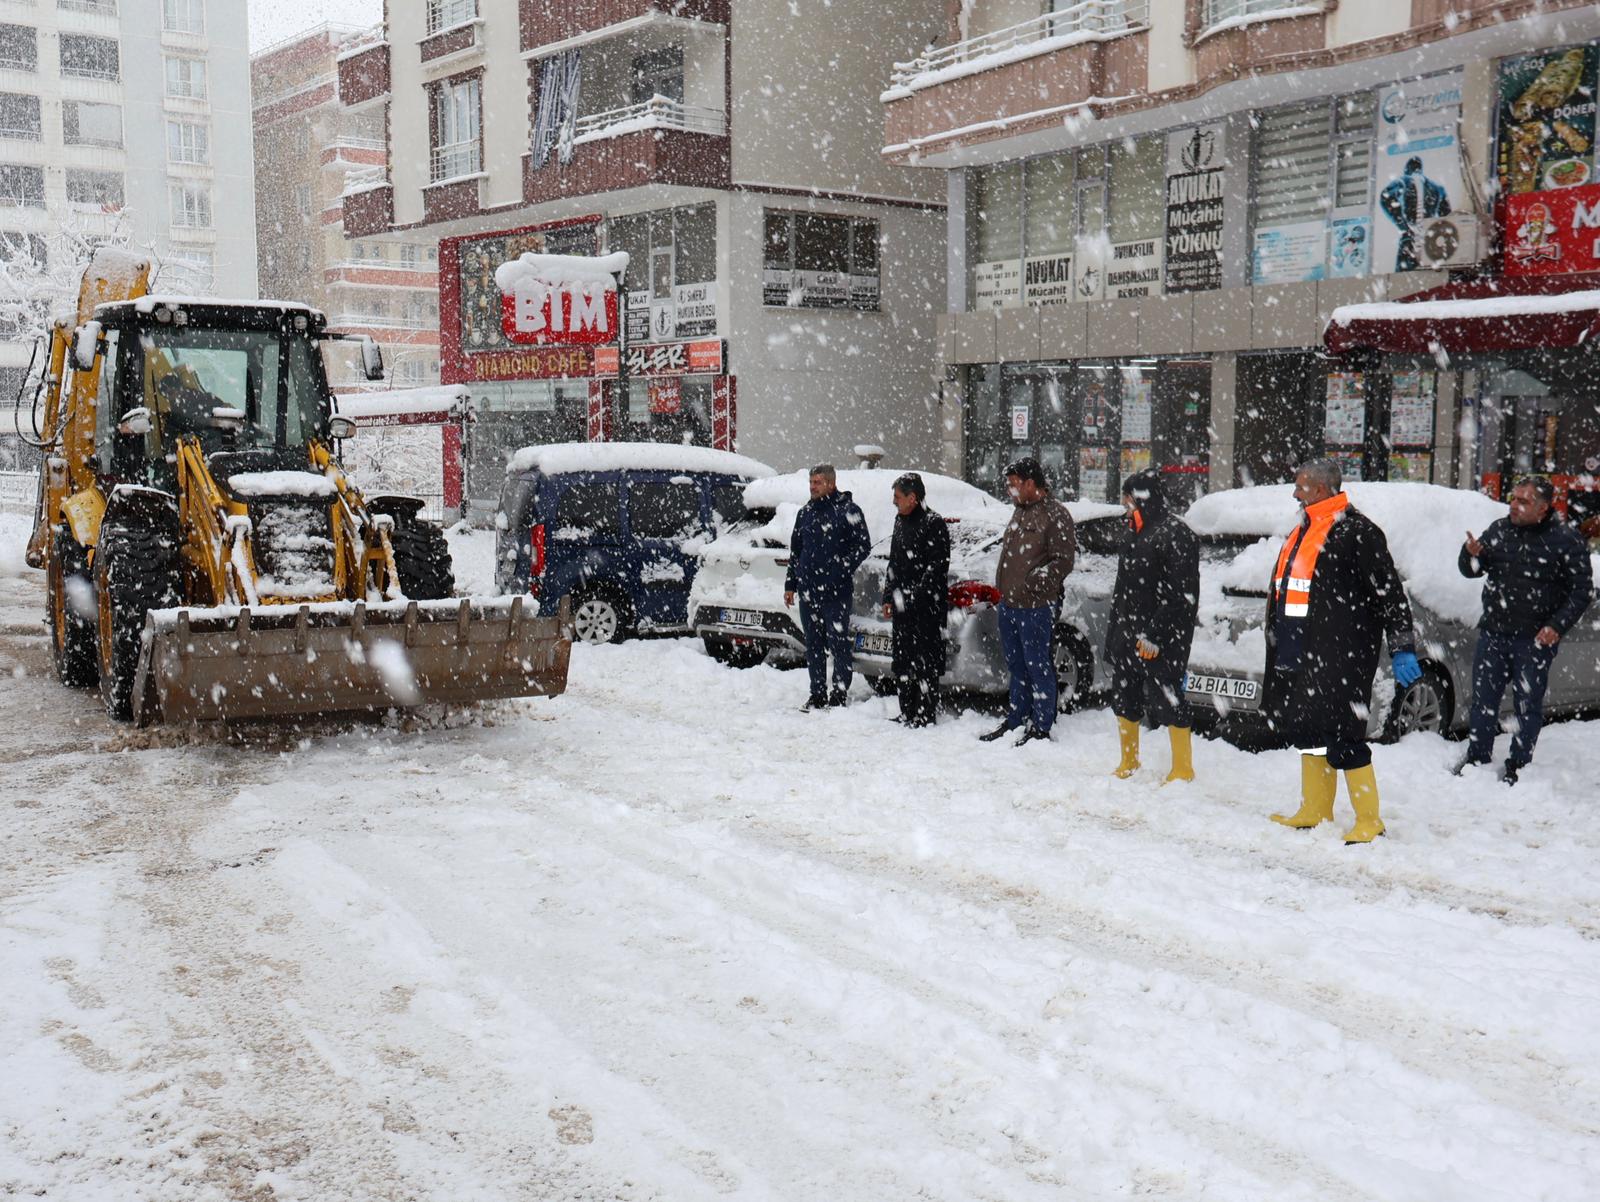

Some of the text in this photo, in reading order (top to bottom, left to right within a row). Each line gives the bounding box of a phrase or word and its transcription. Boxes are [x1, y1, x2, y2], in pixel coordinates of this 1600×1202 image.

[1553, 102, 1597, 119] DÖNER
[1169, 203, 1224, 228] Mücahit
[1025, 257, 1070, 285] AVUKAT
[628, 295, 648, 305] UKAT
[1028, 286, 1067, 297] Mücahit
[476, 352, 588, 377] DIAMOND CAFE
[1188, 676, 1255, 697] 34 BIA 109
